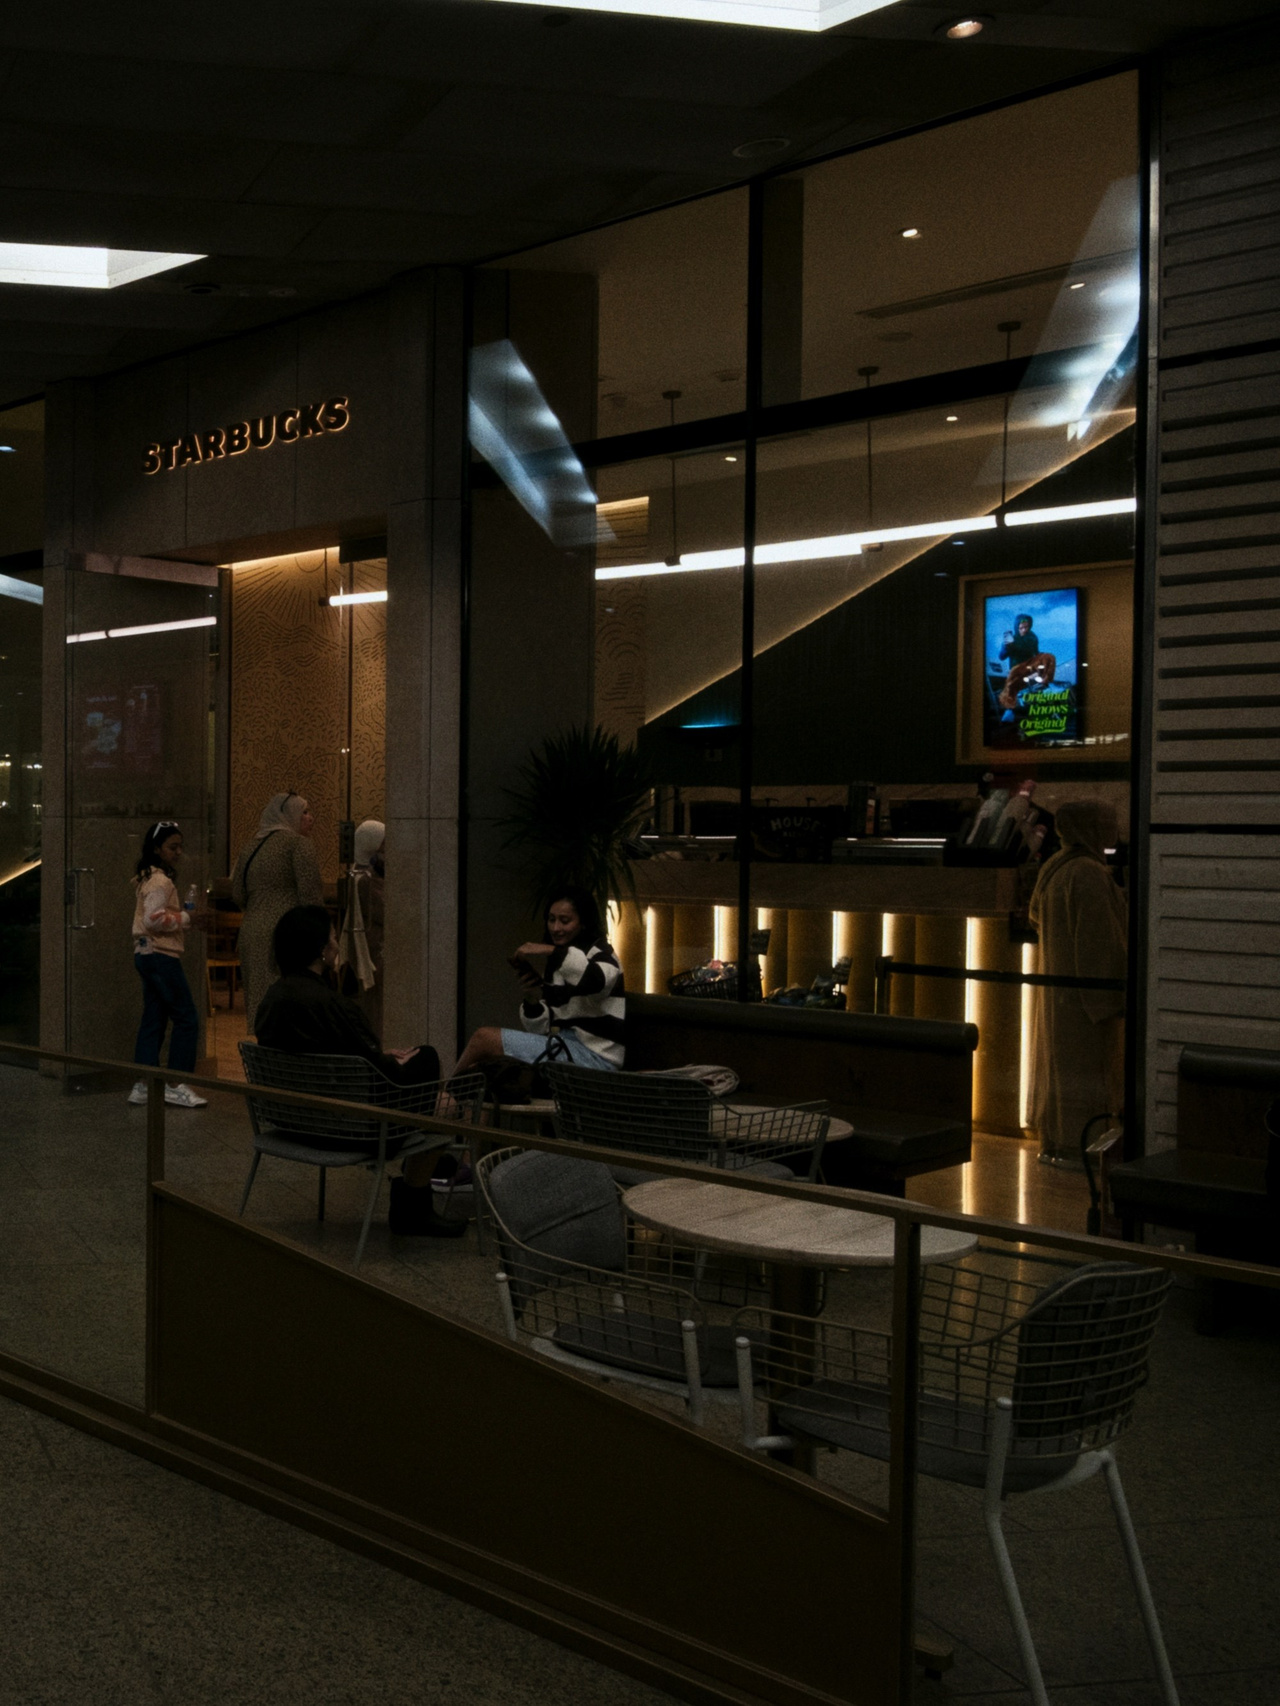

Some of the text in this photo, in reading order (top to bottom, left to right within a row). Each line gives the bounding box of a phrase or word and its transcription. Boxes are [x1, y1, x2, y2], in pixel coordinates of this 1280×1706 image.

[140, 396, 350, 475] STARBUCKS
[1023, 688, 1070, 704] Original
[1028, 704, 1068, 716] Knows
[1020, 716, 1067, 730] Original
